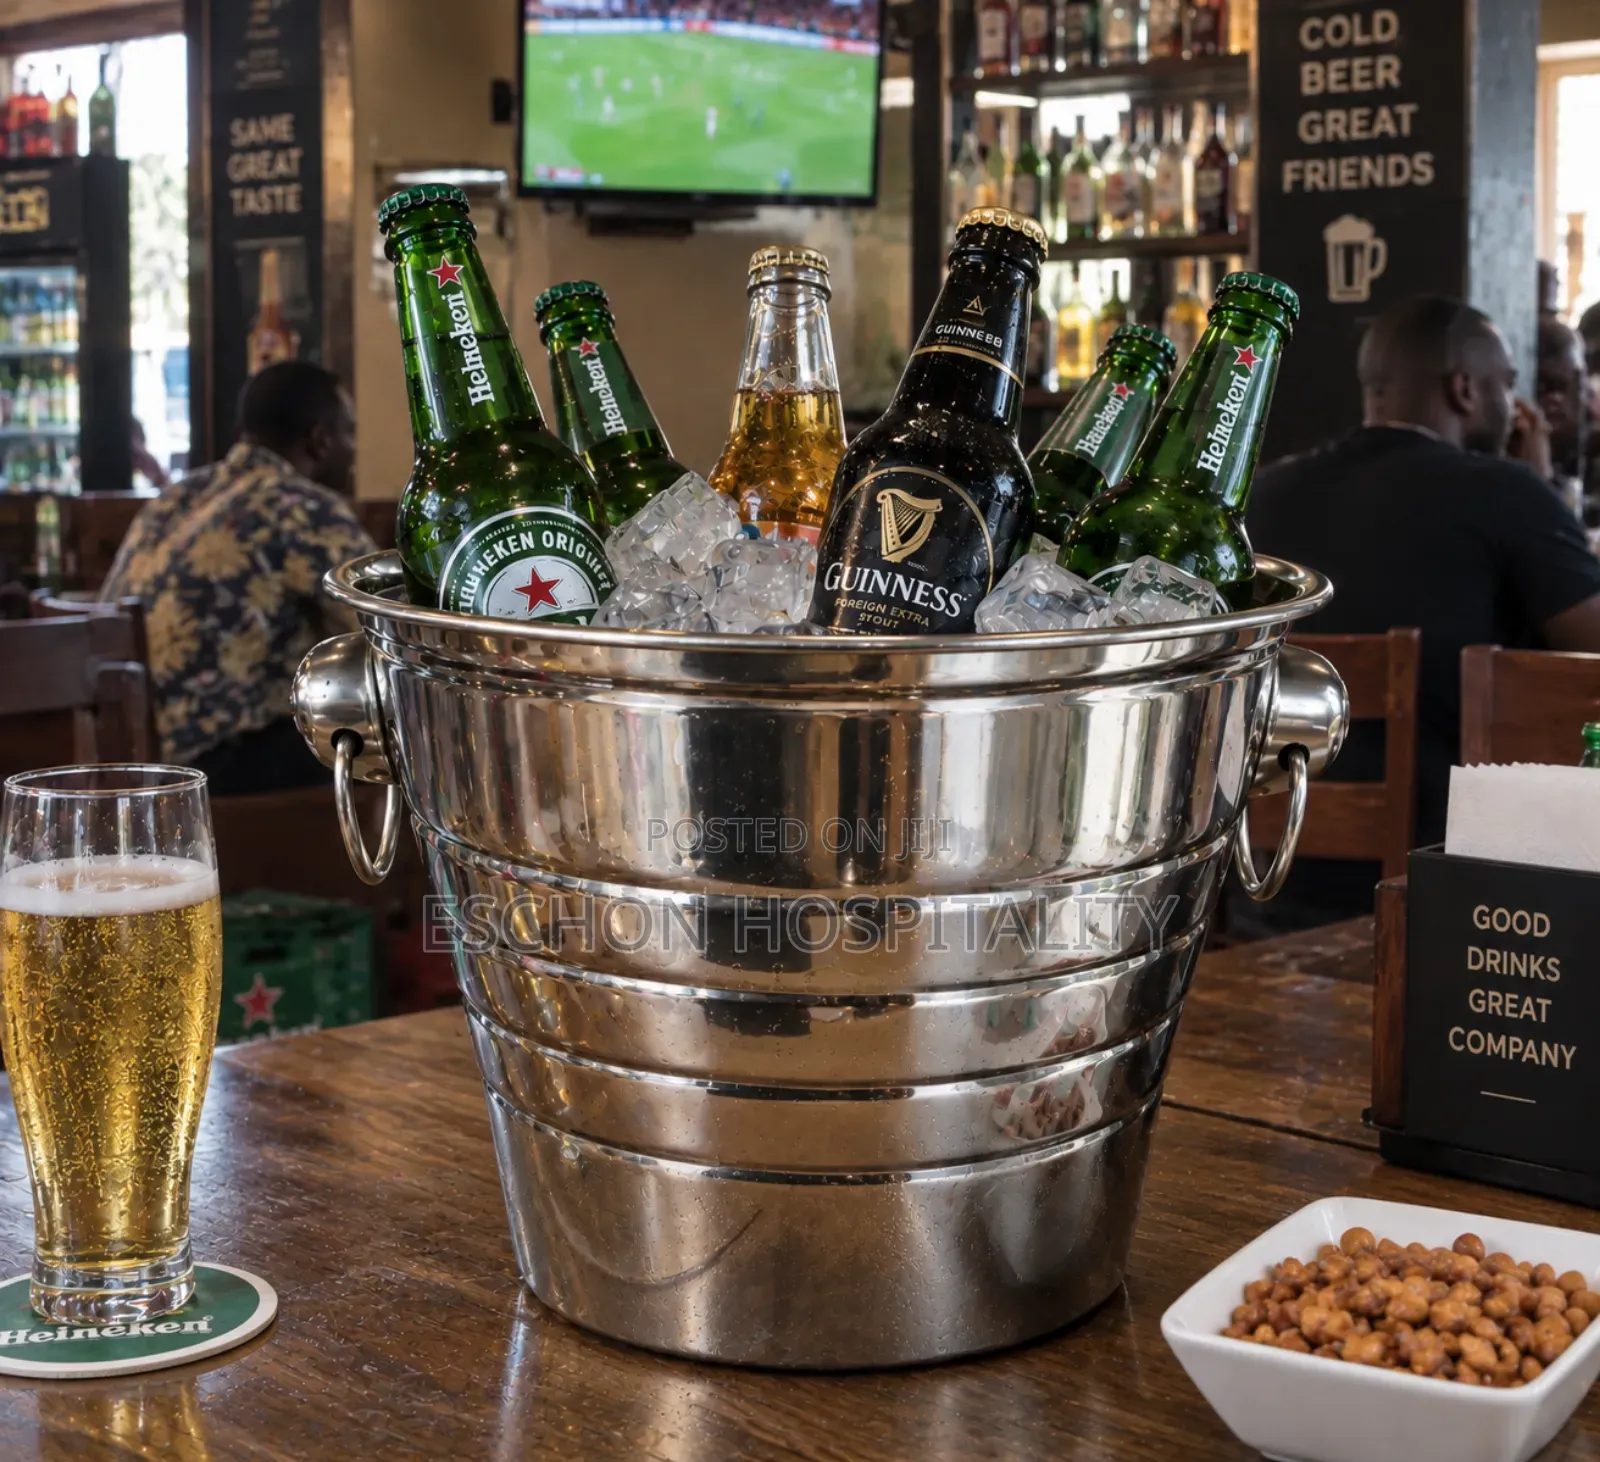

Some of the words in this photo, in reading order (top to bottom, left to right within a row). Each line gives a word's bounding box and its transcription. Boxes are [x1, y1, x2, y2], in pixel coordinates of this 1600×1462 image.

[1299, 9, 1399, 50] COLD
[1301, 54, 1401, 95] BEER
[230, 112, 295, 148] SAME
[1297, 103, 1419, 143] GREAT
[226, 147, 304, 183] GREAT
[1282, 152, 1434, 193] FRIENDS
[229, 182, 302, 217] TASTE
[824, 562, 963, 618] GUINNESS
[834, 598, 887, 614] FOREIGN
[890, 606, 930, 627] EXTRA
[859, 612, 899, 628] STOUT
[1473, 904, 1551, 938] GOOD
[1467, 946, 1561, 983] DRINKS
[1468, 988, 1552, 1023] GREAT
[1448, 1026, 1577, 1070] COMPANY
[0, 1317, 212, 1345] Heineken
